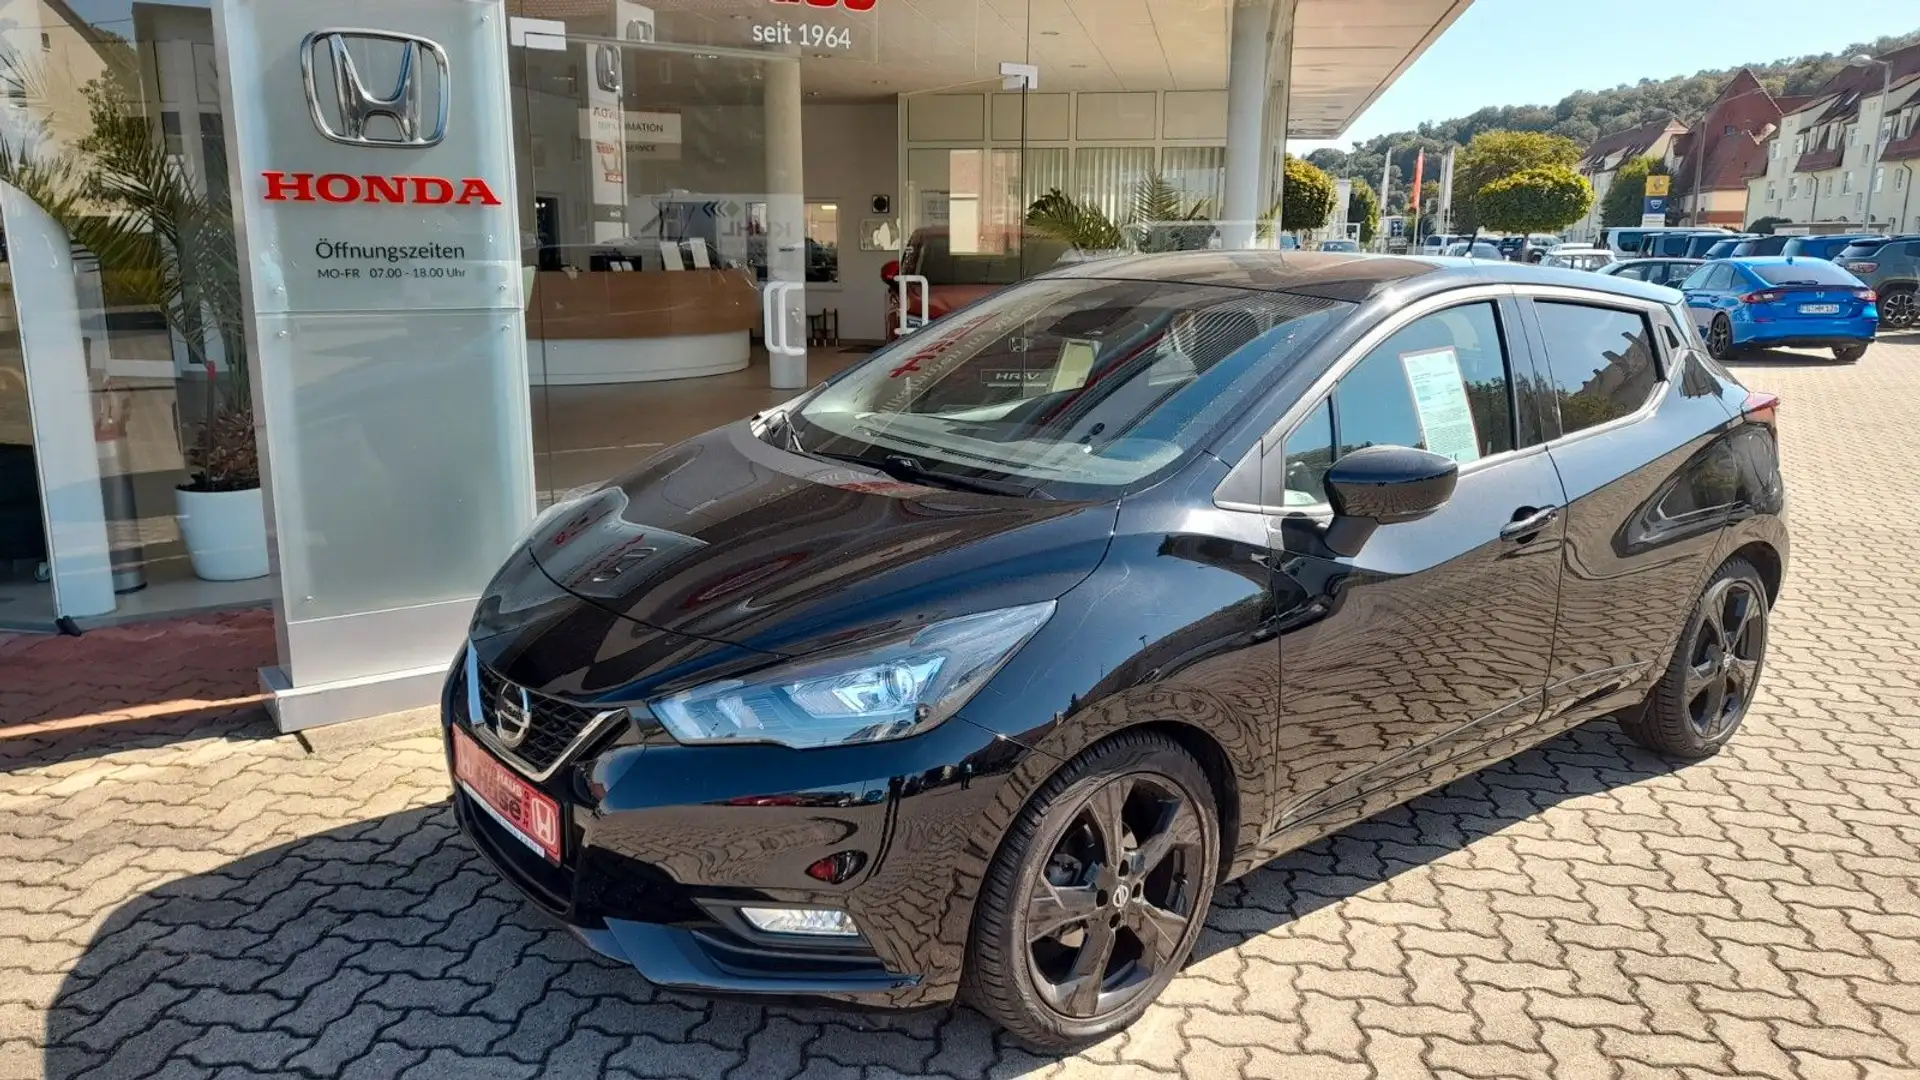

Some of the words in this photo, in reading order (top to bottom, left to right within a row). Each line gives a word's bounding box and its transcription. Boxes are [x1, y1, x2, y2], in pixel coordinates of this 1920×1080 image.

[752, 21, 792, 44] seit
[799, 23, 851, 49] 1964
[261, 171, 503, 206] HONDA
[315, 238, 465, 263] Öffnungszeiten
[317, 268, 361, 279] MO-FR
[369, 267, 402, 279] 07.00
[413, 267, 444, 278] 18.00
[446, 267, 465, 278] Uhr
